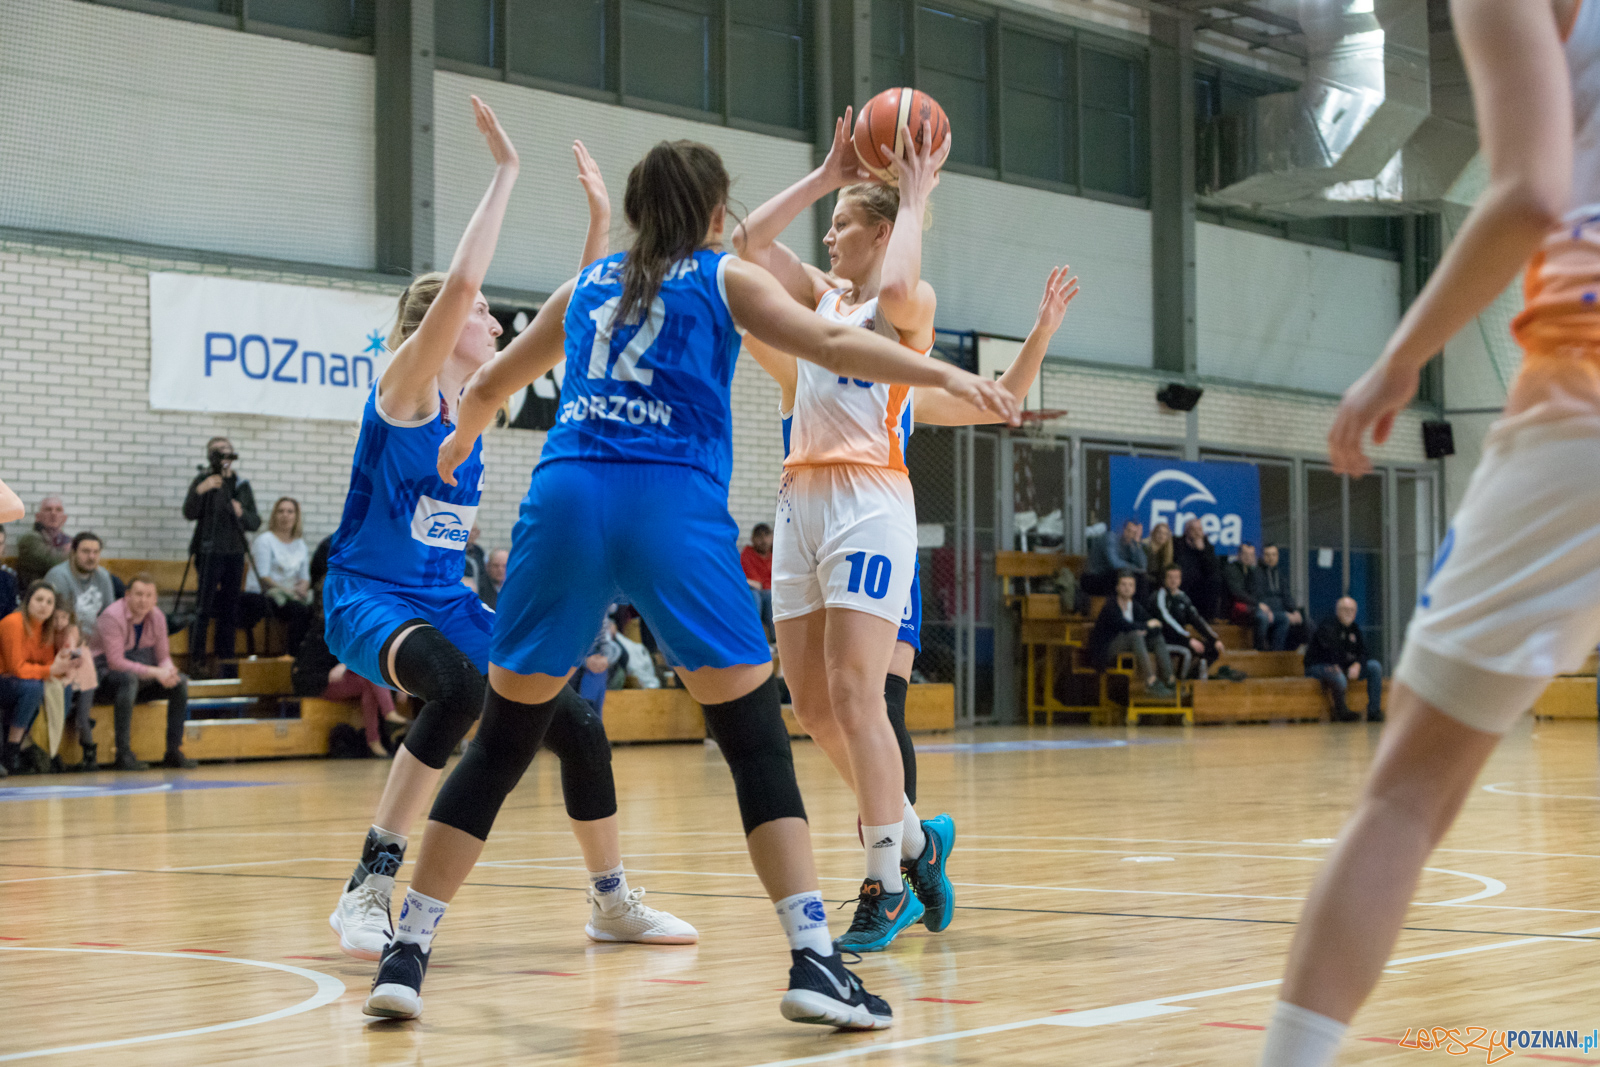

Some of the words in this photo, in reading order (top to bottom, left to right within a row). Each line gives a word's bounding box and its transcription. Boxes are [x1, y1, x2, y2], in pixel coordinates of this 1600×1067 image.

[587, 296, 666, 386] 12
[427, 521, 470, 543] Enea
[845, 551, 892, 600] 10
